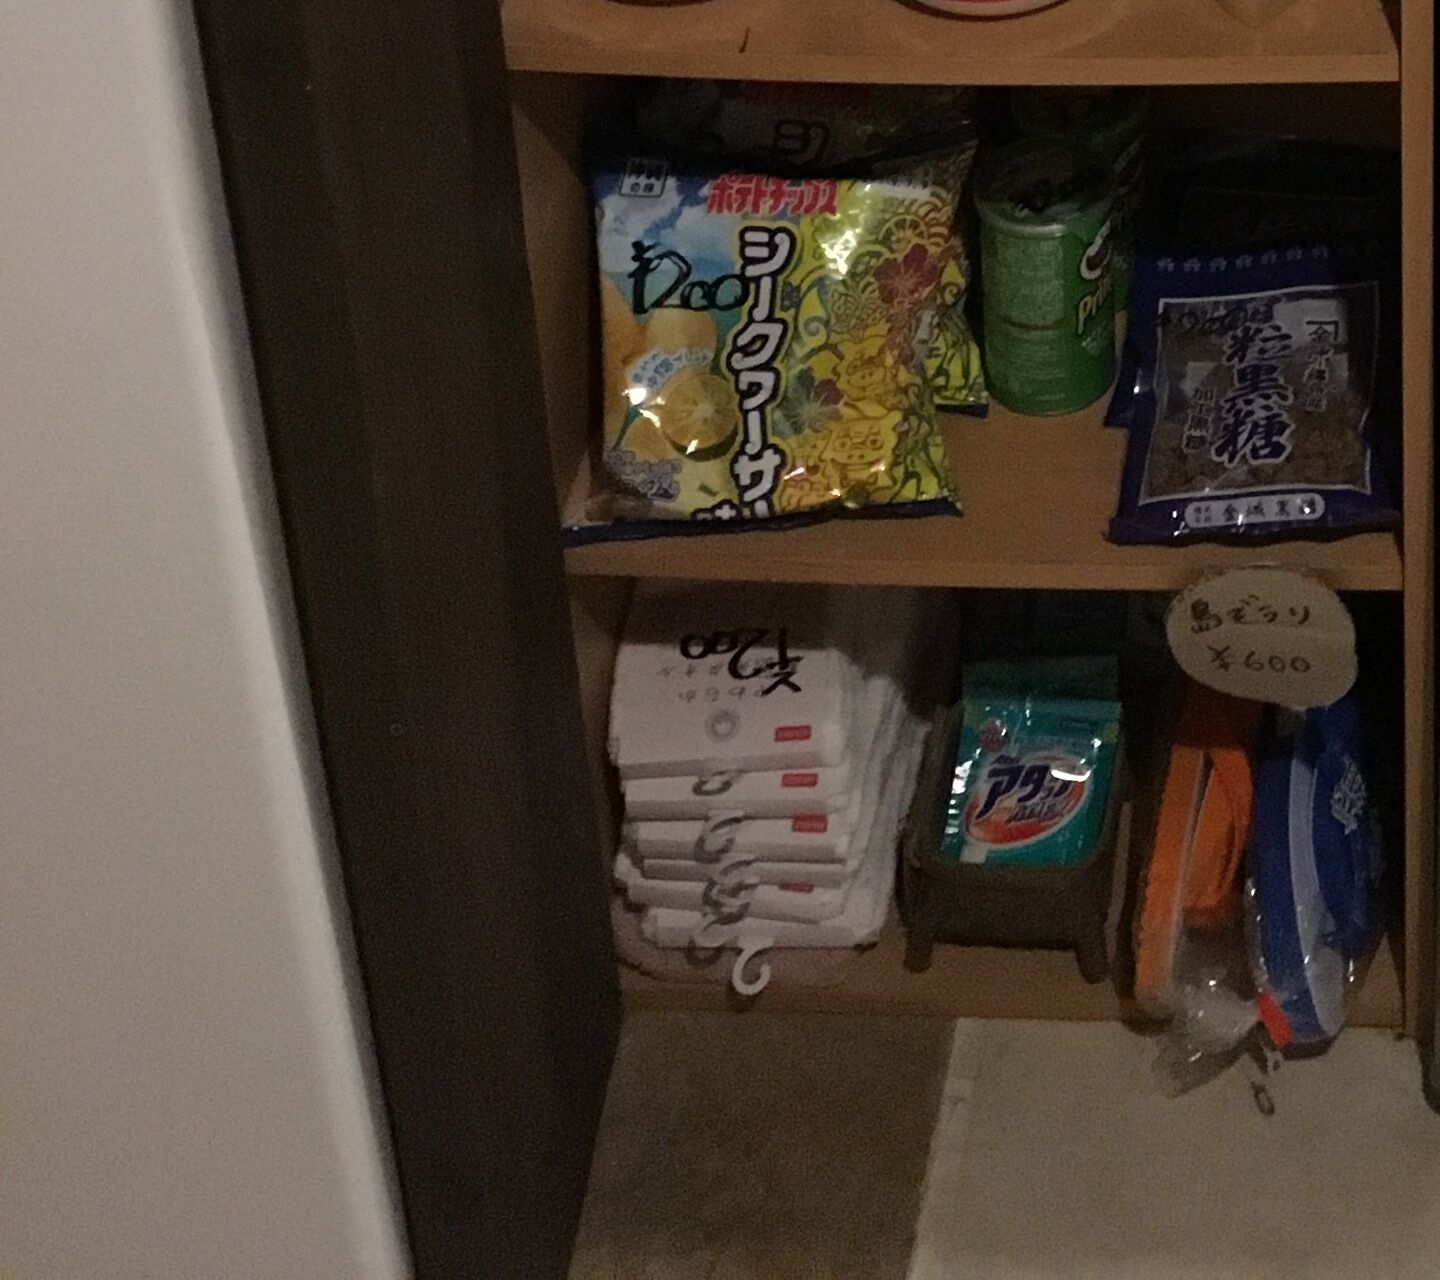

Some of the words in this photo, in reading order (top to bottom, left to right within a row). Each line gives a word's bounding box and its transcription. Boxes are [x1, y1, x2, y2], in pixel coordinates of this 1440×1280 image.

[706, 175, 838, 216] ポテトチップス
[1211, 322, 1296, 468] 粒黒糖
[1206, 645, 1312, 674] ¥600
